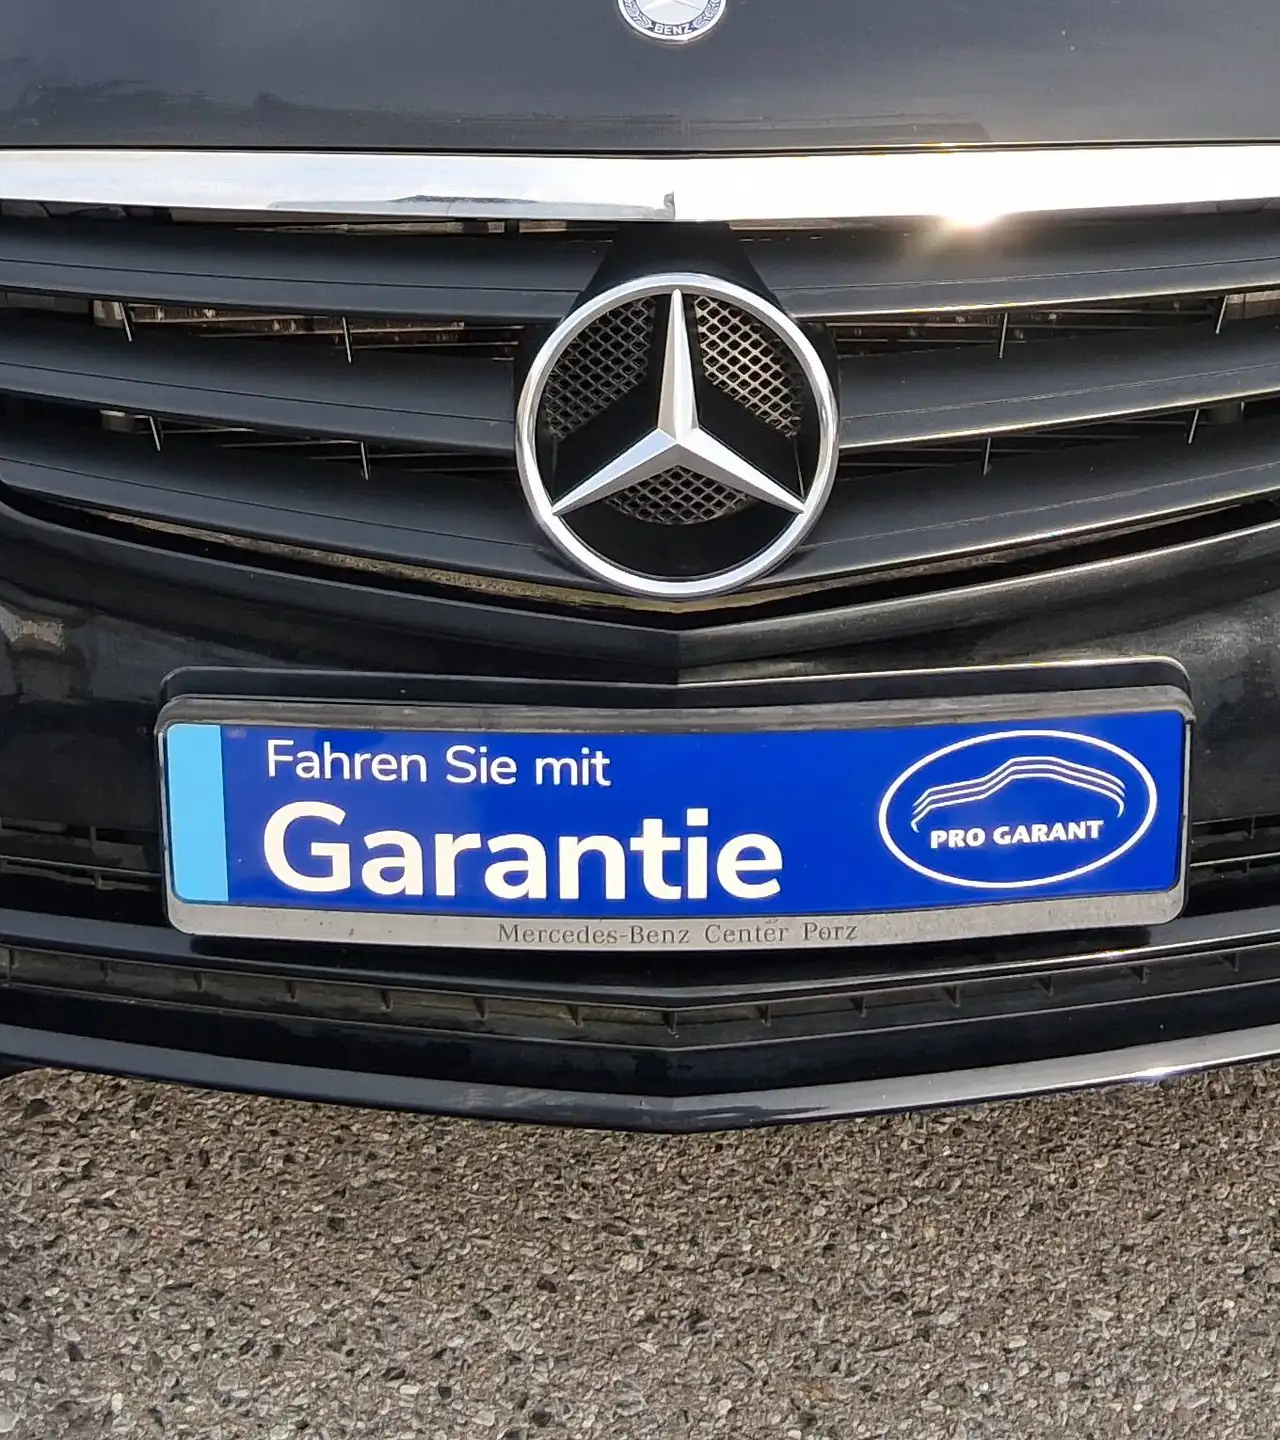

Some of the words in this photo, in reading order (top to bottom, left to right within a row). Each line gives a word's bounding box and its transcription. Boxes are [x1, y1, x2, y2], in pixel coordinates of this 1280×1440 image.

[654, 23, 694, 35] BENZ
[266, 739, 428, 783] Fahren
[445, 744, 517, 785] Sie
[535, 747, 612, 787] mit
[930, 828, 986, 849] PRO
[993, 819, 1105, 846] GARANT
[262, 801, 784, 901] Garantie
[497, 922, 690, 945] Mercedes-Benz
[704, 922, 789, 944] Center
[803, 921, 859, 942] Porz
